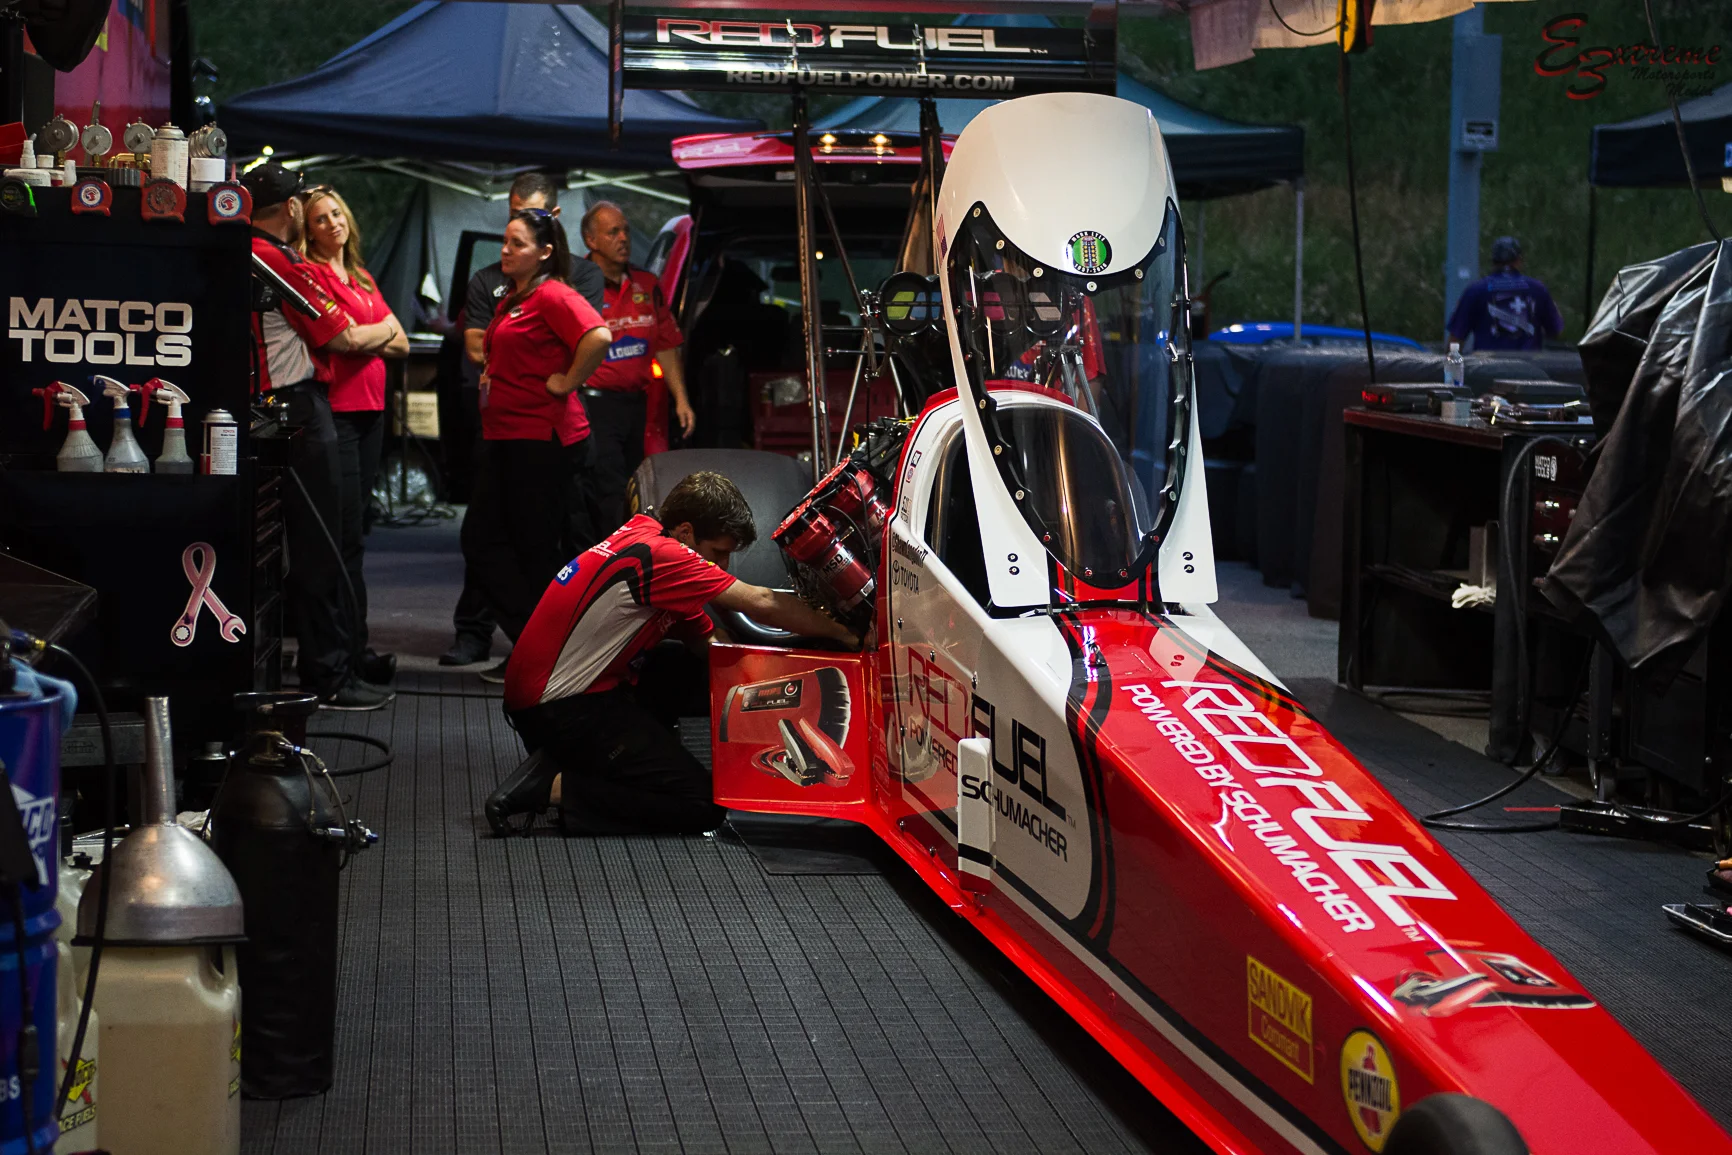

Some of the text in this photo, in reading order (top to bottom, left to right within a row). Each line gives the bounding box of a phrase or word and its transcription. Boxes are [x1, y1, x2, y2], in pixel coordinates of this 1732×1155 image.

[726, 70, 1015, 91] REDFUELPOWER.COM
[9, 297, 193, 334] MATCO
[8, 329, 193, 367] TOOLS
[1534, 455, 1550, 467] MATCO
[1535, 466, 1550, 478] TOOLS
[822, 553, 843, 576] MSD
[901, 566, 919, 594] TOYOTA
[909, 716, 958, 778] POWERED
[971, 691, 1066, 822] FUEL
[961, 774, 1068, 863] SCHUMACHER
[1120, 683, 1376, 933] POWERED BY SCHUMACHER
[1249, 962, 1311, 1041] SANDVIK
[1260, 1015, 1299, 1062] Coromant
[1347, 1068, 1393, 1112] PENNZOIL
